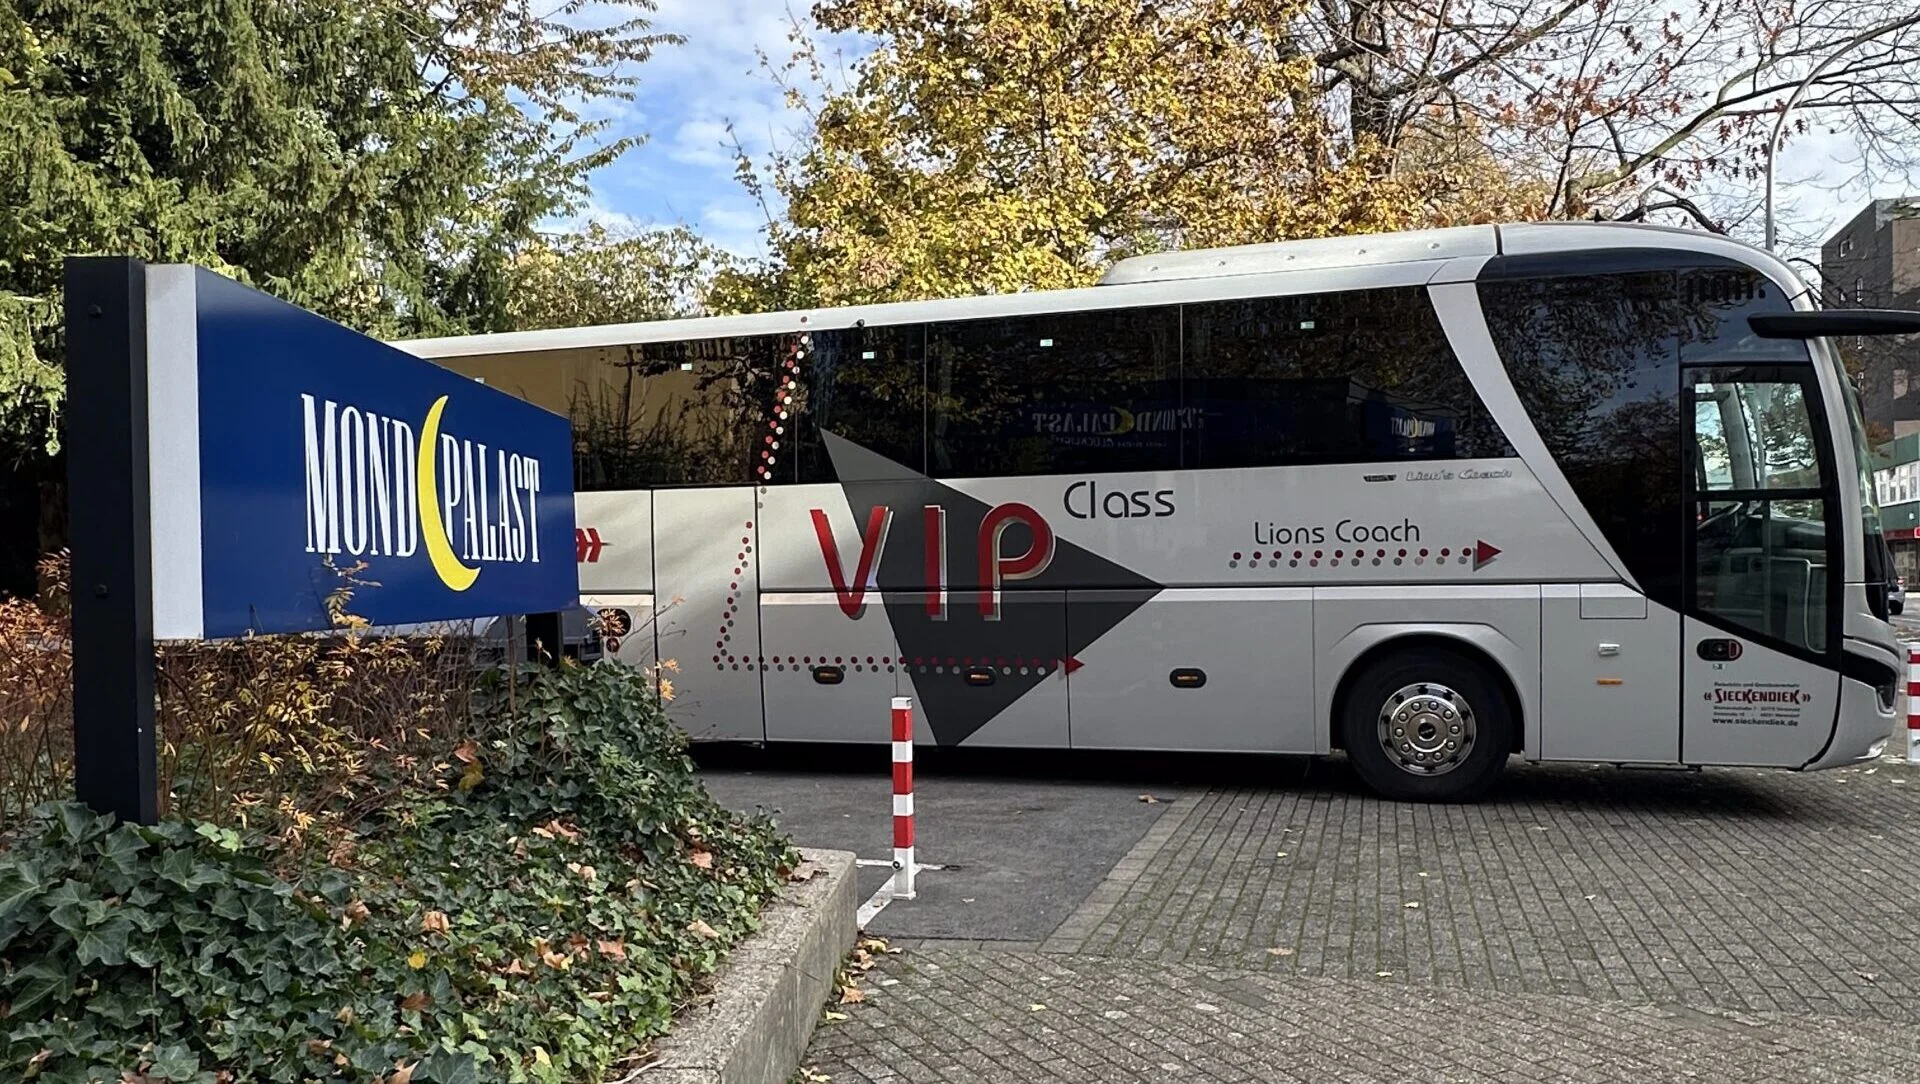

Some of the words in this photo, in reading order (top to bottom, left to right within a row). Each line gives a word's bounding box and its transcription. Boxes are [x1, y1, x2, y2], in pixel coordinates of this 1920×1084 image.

[1062, 480, 1176, 520] Class
[1254, 521, 1326, 546] Lions
[1335, 518, 1421, 543] Coach
[809, 502, 1057, 622] VIP
